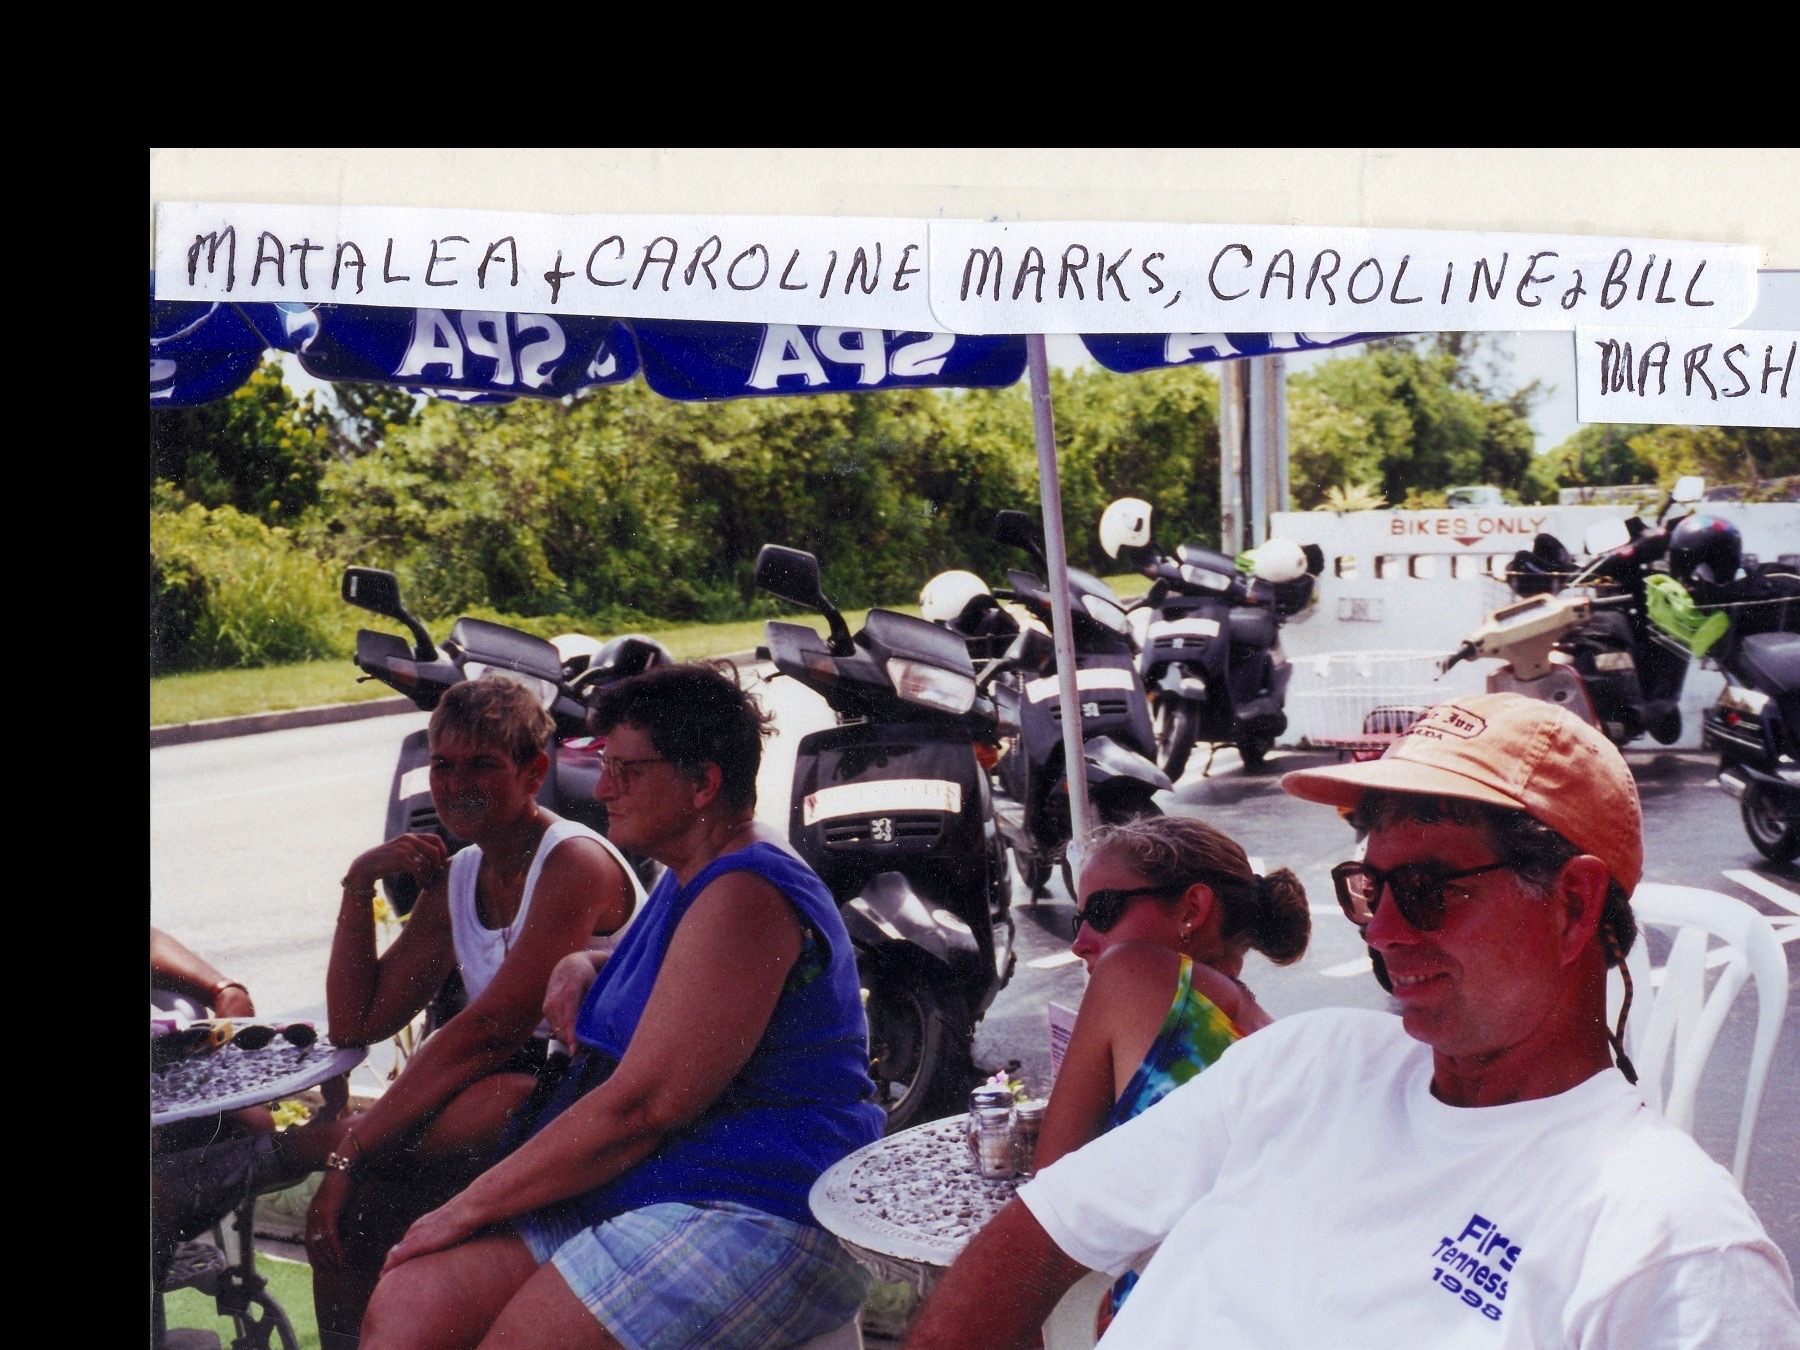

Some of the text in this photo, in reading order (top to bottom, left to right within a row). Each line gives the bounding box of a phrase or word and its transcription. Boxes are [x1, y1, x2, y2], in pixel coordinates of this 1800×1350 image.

[187, 225, 519, 295] MATALEA
[585, 235, 921, 299] CAROLINE
[960, 243, 1182, 309] MARKS,
[1208, 243, 1559, 308] CAROLINE
[1600, 248, 1715, 311] BILL
[1597, 338, 1797, 401] MARSH
[1391, 517, 1547, 535] BIKES ONLY
[1432, 1267, 1503, 1321] 1998
